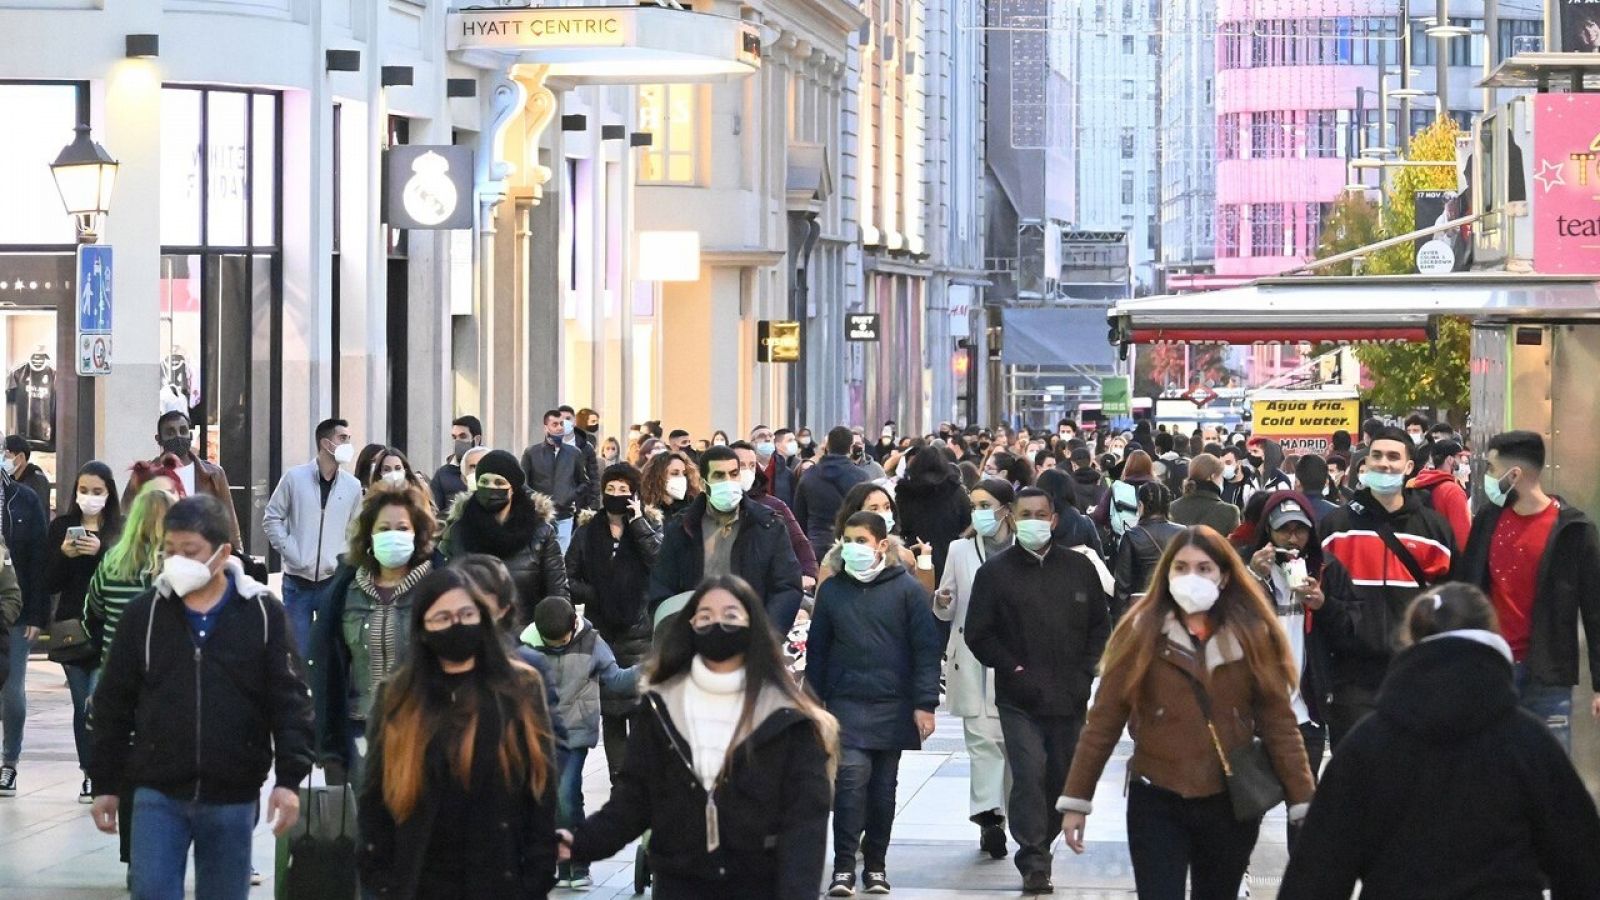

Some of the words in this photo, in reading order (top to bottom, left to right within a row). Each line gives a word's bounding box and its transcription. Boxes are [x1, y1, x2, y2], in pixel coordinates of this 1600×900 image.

[463, 21, 523, 36] HYATT
[530, 18, 617, 36] CENTRIC
[1570, 153, 1600, 185] T
[1266, 400, 1307, 412] Agua
[1261, 416, 1295, 426] Cold
[1300, 417, 1350, 426] water.
[1280, 439, 1327, 449] MADRID
